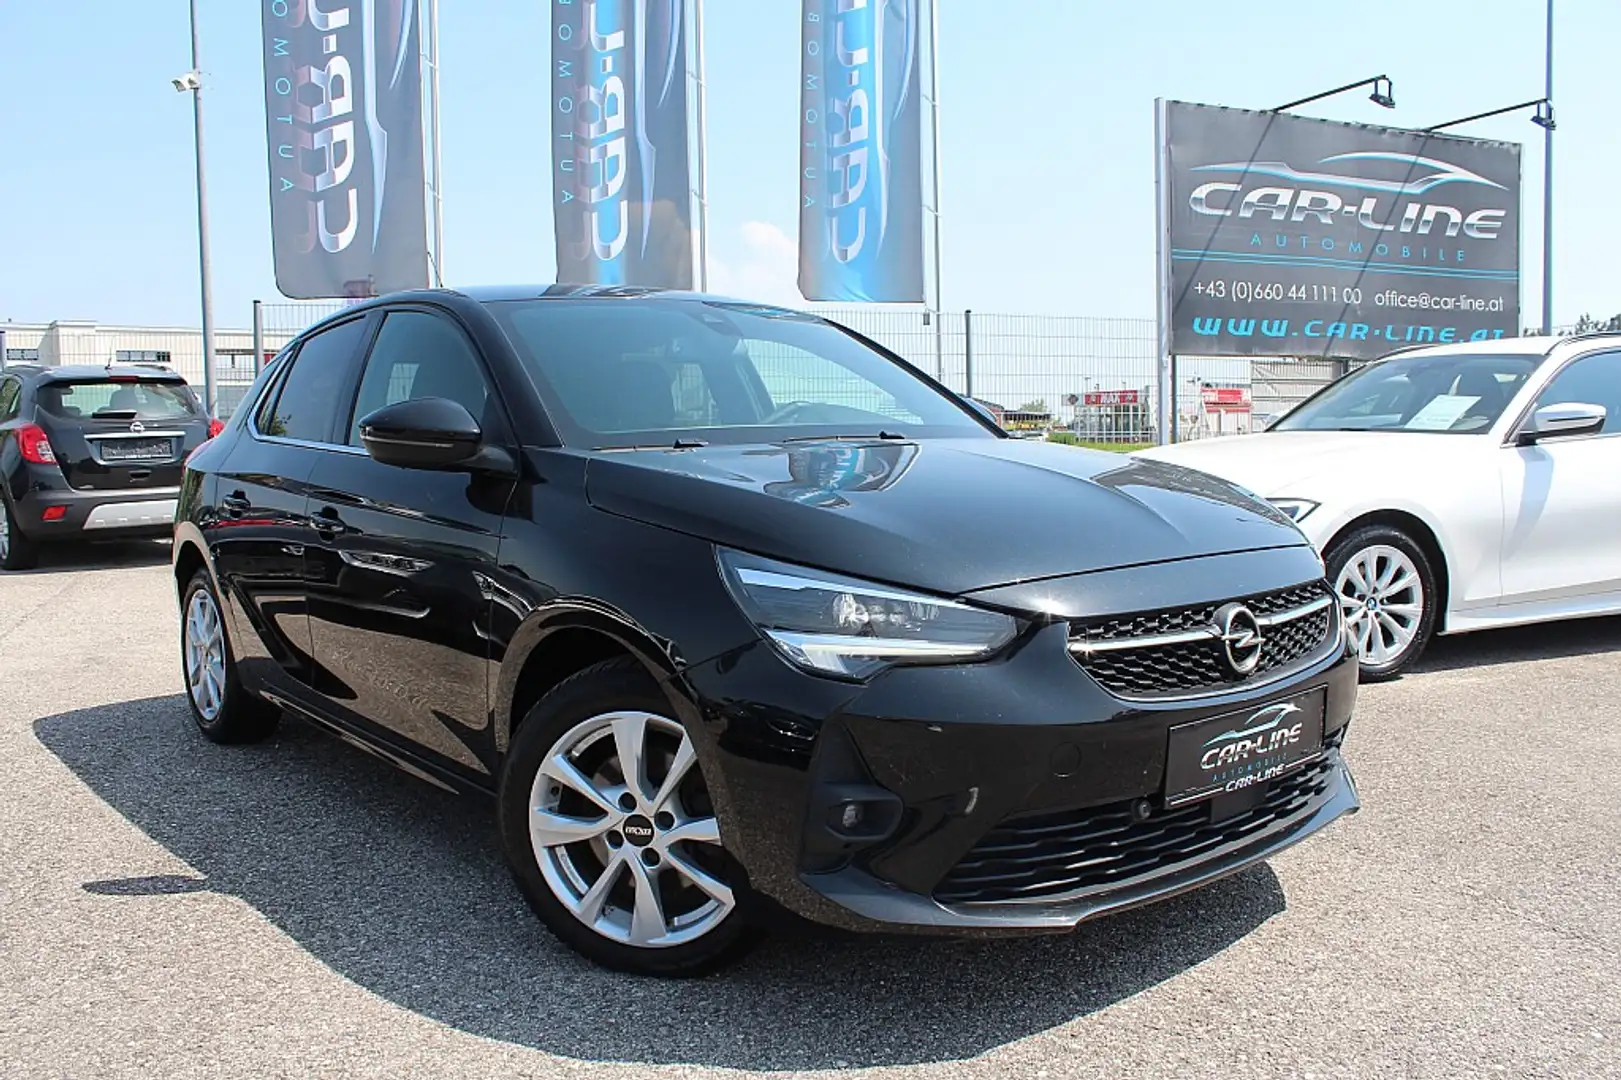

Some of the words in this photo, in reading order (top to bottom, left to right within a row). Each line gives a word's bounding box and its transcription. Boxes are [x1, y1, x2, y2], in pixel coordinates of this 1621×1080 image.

[1189, 182, 1507, 239] CAR-LINE
[1250, 234, 1465, 262] AUTOMOBILE
[1194, 280, 1225, 298] +43
[1231, 281, 1284, 303] (0)660
[1288, 284, 1307, 300] 44
[1312, 285, 1337, 302] 111
[1343, 288, 1362, 304] 00
[1374, 289, 1504, 312] office@car-line.at
[1201, 722, 1303, 770] CAR-LINE
[1225, 763, 1286, 793] CAR-LINE
